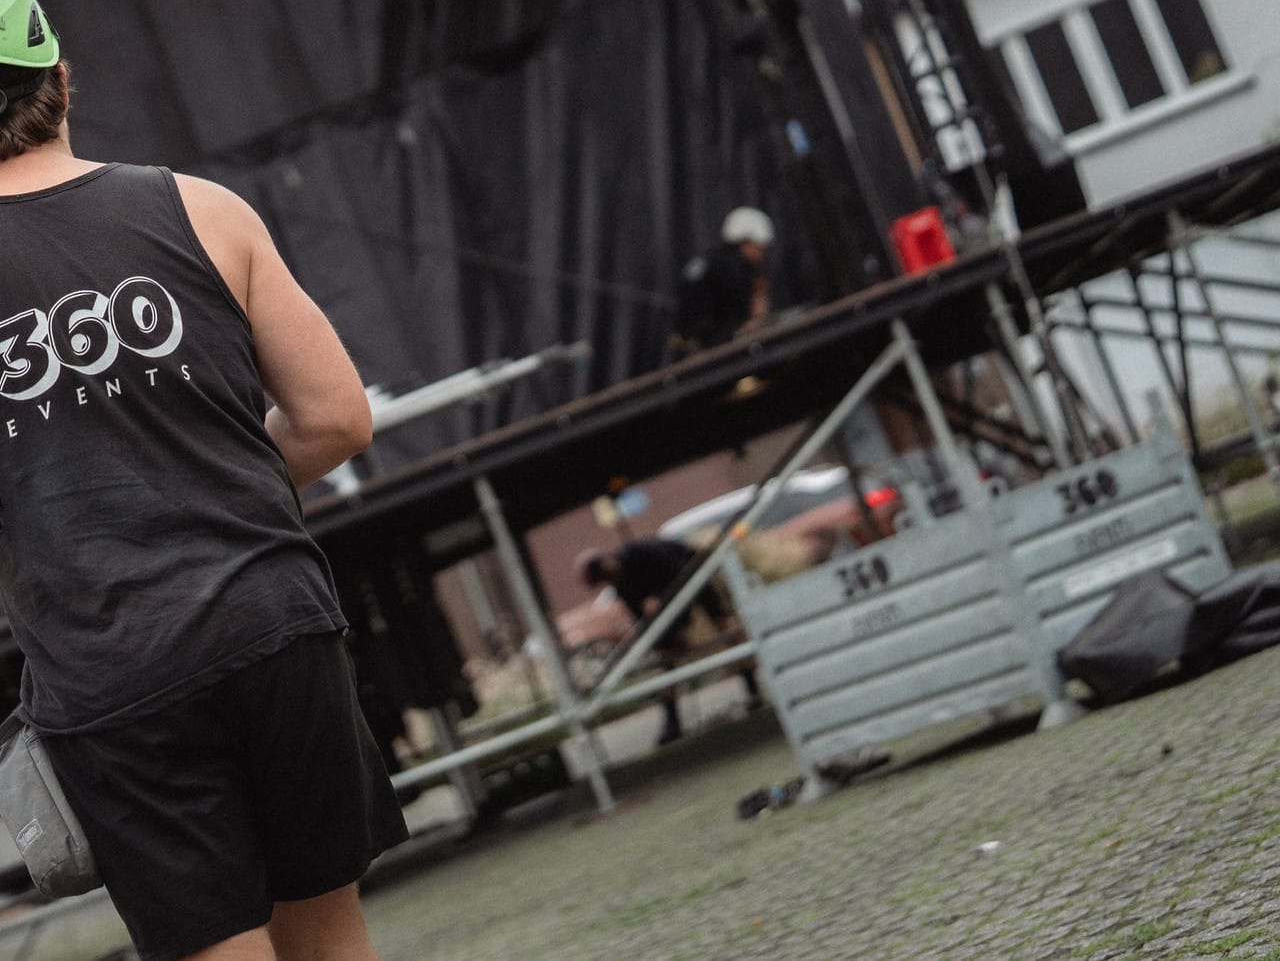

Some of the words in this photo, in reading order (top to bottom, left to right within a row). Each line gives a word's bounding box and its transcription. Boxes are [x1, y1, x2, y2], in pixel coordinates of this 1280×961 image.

[6, 365, 191, 438] EVENTS
[1054, 468, 1119, 516] 360
[836, 554, 891, 600] 360
